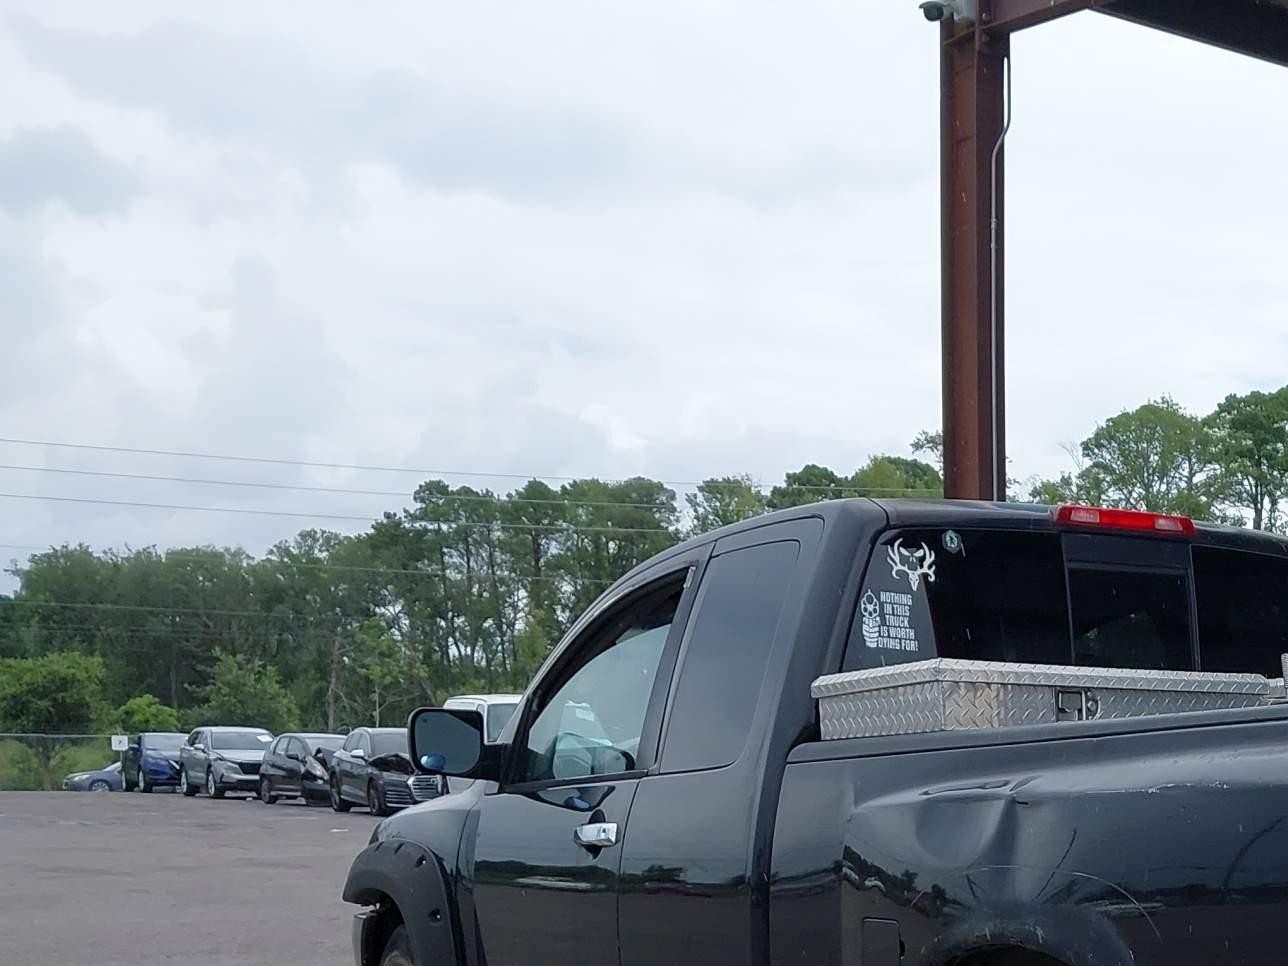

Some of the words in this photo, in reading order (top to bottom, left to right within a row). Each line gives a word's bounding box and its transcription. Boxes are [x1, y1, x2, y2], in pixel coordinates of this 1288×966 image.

[880, 591, 912, 605] NOTHING
[884, 603, 892, 614] IN
[893, 604, 909, 616] THIS
[885, 615, 909, 627] TRUCK
[880, 625, 888, 637] IS
[889, 626, 915, 640] WORTH
[878, 637, 900, 649] DYING
[901, 640, 918, 651] FOR!
